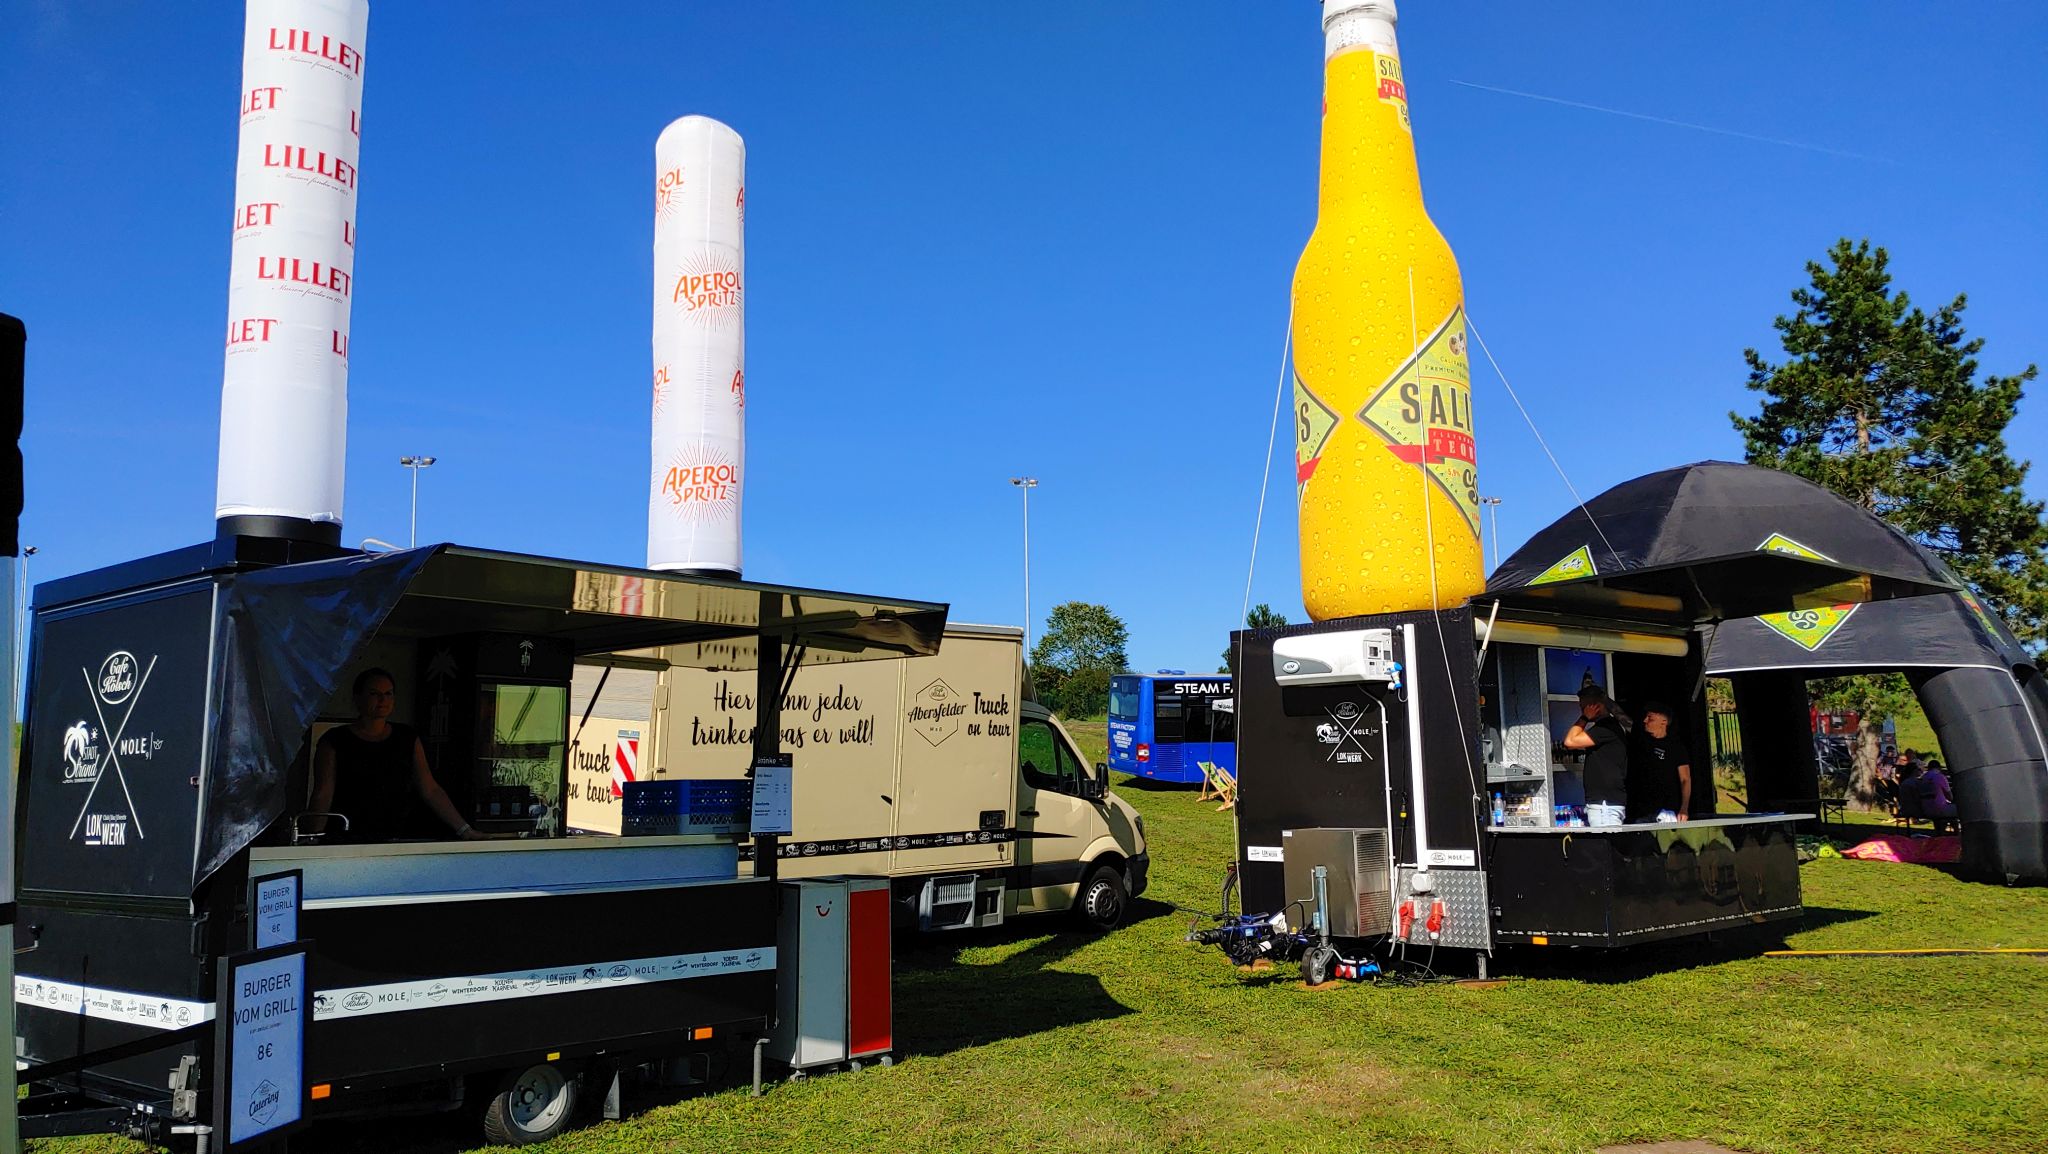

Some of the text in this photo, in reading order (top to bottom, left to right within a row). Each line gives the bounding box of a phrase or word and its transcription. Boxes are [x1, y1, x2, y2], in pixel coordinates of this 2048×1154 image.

[268, 27, 363, 77] LILLET
[264, 143, 357, 190] LILLET
[258, 256, 351, 297] LILLET
[674, 271, 741, 303] APEROL
[662, 464, 737, 495] APEROL
[102, 673, 132, 693] Kölsch
[1174, 682, 1233, 694] STEAM F
[714, 680, 755, 711] Hier
[813, 684, 863, 722] jeder
[908, 702, 967, 723] Abersfelder
[973, 691, 1009, 716] Truck
[813, 729, 832, 744] er
[839, 715, 874, 746] will!
[967, 720, 1011, 737] on tour
[572, 740, 611, 774] Truck
[587, 778, 612, 804] tour
[86, 815, 102, 836] LOK
[102, 823, 126, 845] WERK
[263, 887, 290, 900] BURGER
[275, 900, 294, 911] GRILL
[244, 973, 291, 998] BURGER
[452, 985, 488, 995] WINTERDORF
[546, 973, 577, 985] LOK WERK
[234, 997, 298, 1026] VOM GRILL
[257, 1043, 273, 1060] 8€
[249, 1090, 279, 1117] Catering
